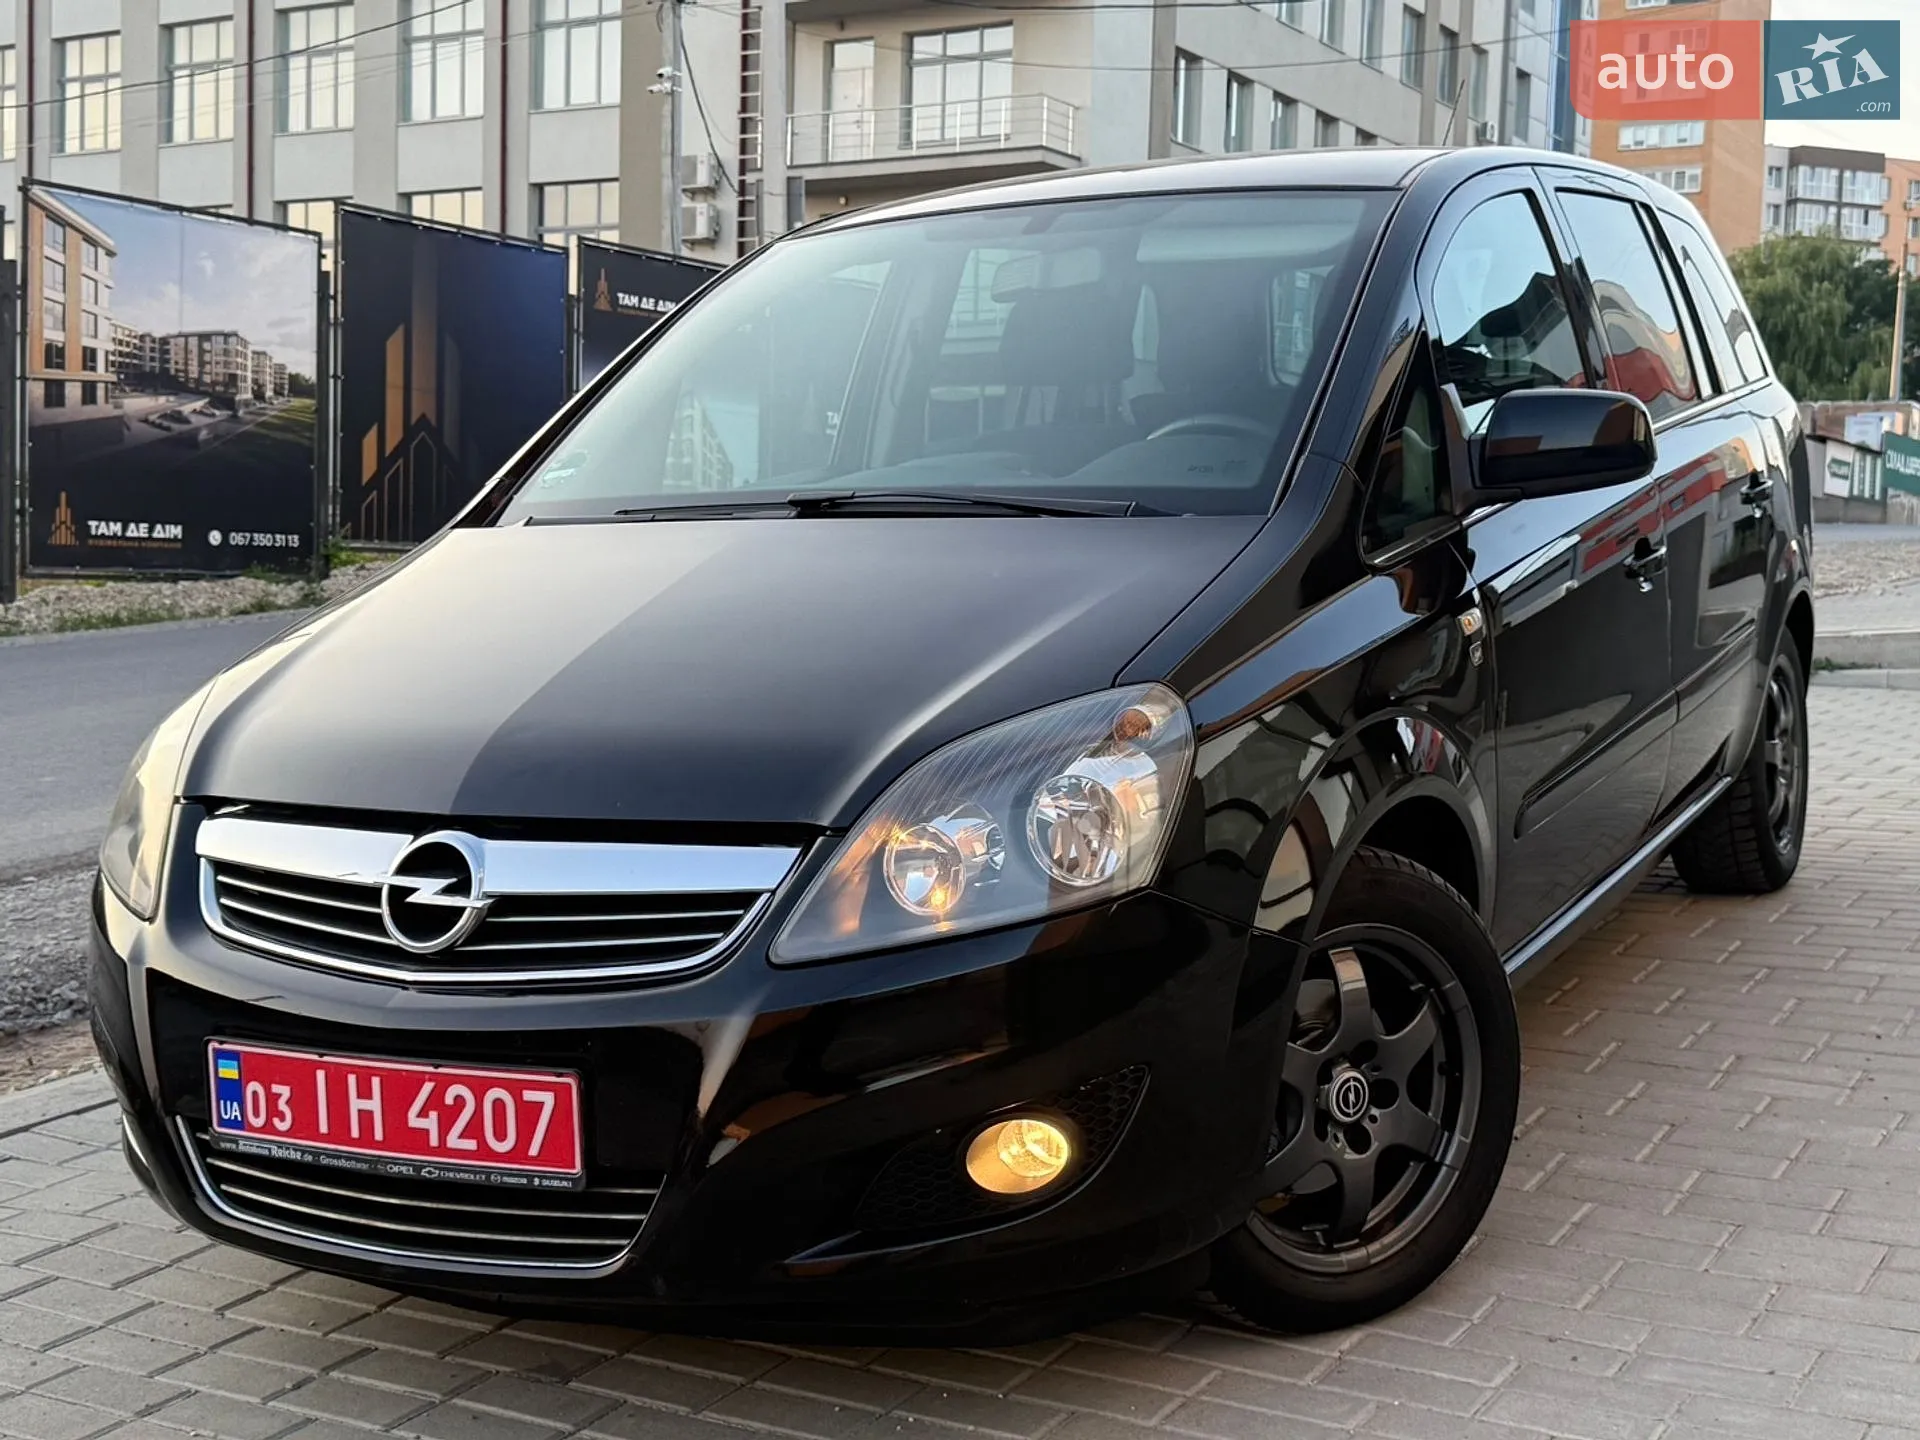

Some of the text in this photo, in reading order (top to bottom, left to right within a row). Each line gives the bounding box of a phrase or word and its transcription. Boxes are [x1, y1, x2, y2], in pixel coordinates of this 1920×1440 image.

[616, 293, 639, 308] ТАМ
[641, 297, 656, 310] ДЕ
[87, 520, 183, 539] ТАМ ДЕ ДІМ
[229, 531, 300, 548] 067 350 31 13
[220, 1100, 241, 1121] UA
[245, 1069, 556, 1157] 03 IH 4207
[386, 1164, 416, 1175] OPEL
